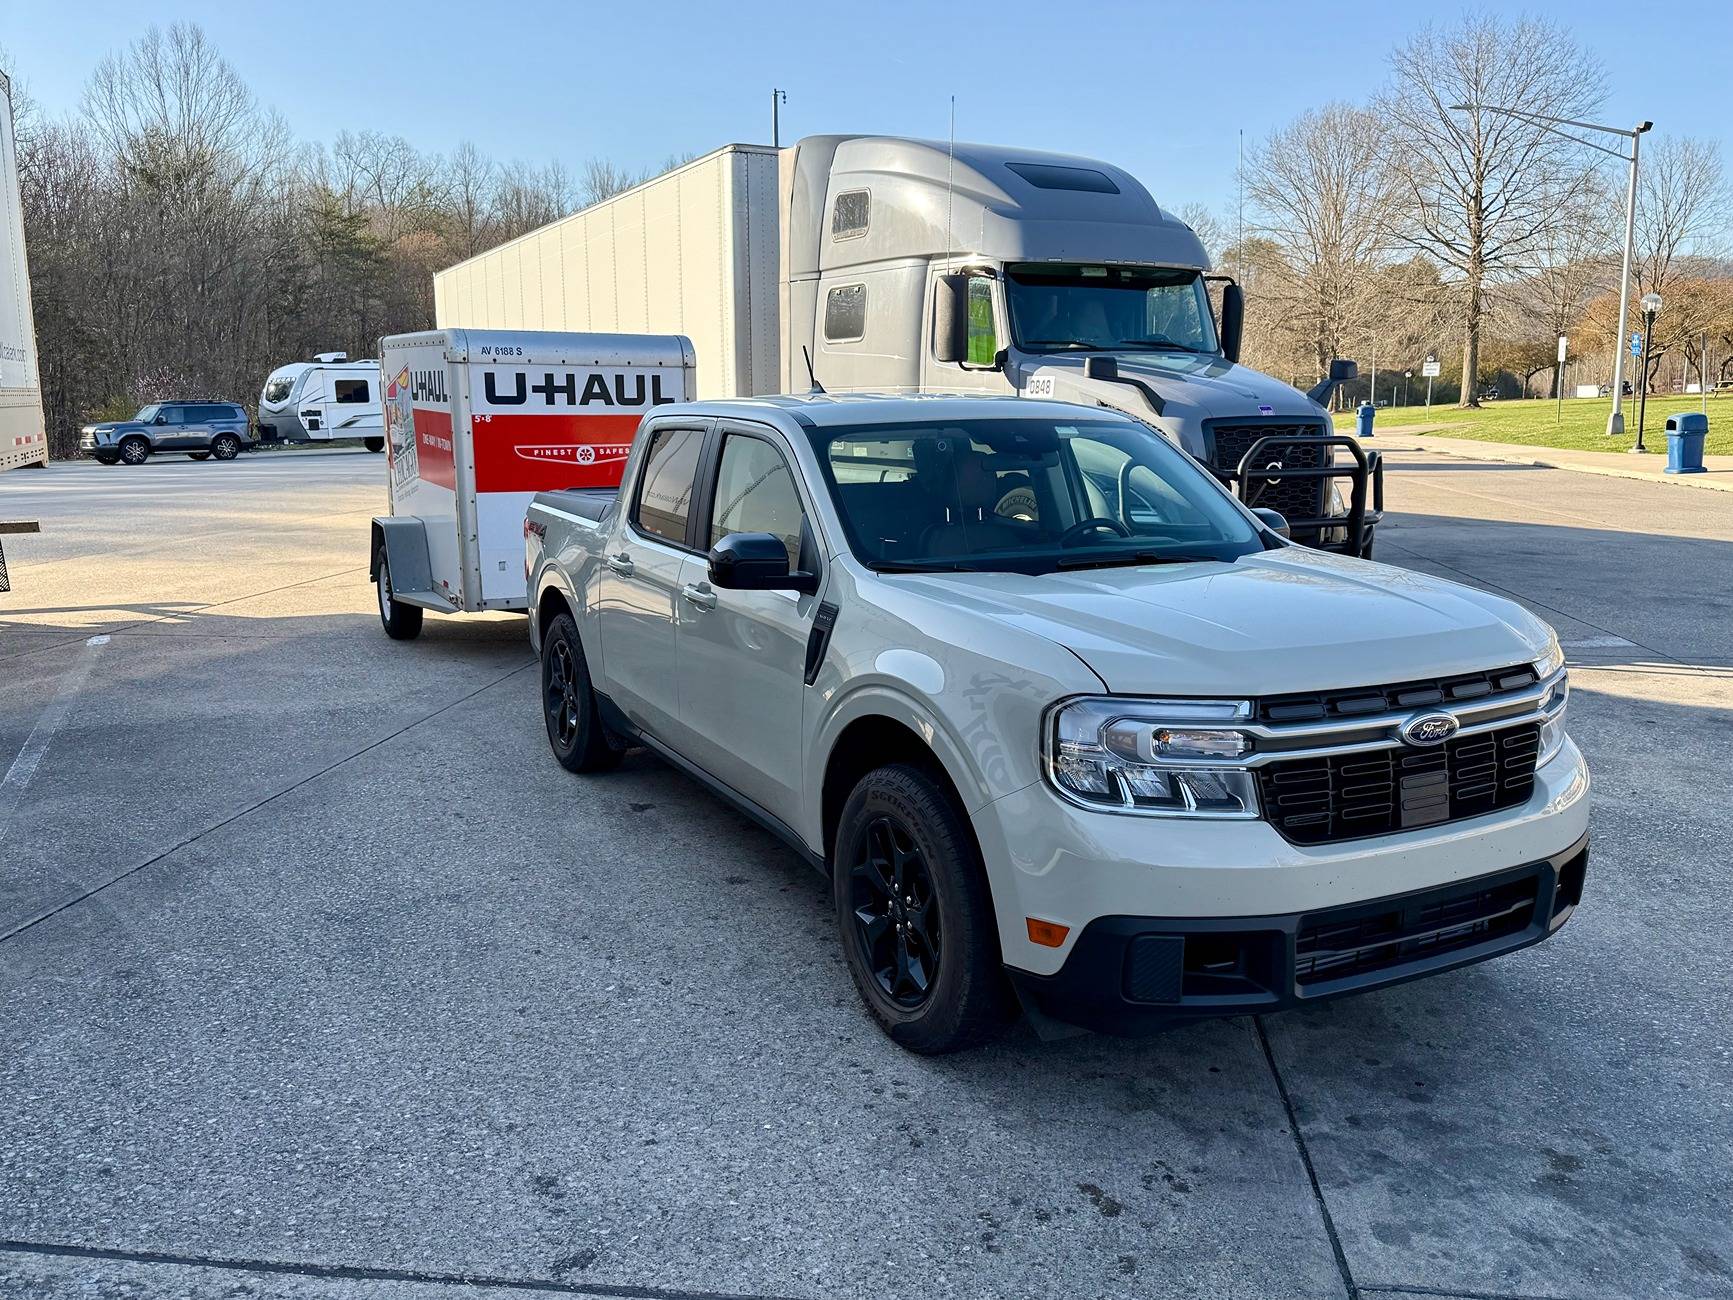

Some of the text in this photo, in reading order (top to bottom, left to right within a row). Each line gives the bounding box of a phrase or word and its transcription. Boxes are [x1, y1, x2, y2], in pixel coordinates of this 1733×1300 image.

[481, 346, 523, 356] AV 6188 S
[410, 370, 448, 403] U-HAUL
[484, 372, 675, 406] U-HAUL
[599, 447, 630, 455] SAFES
[1419, 721, 1449, 740] Ford
